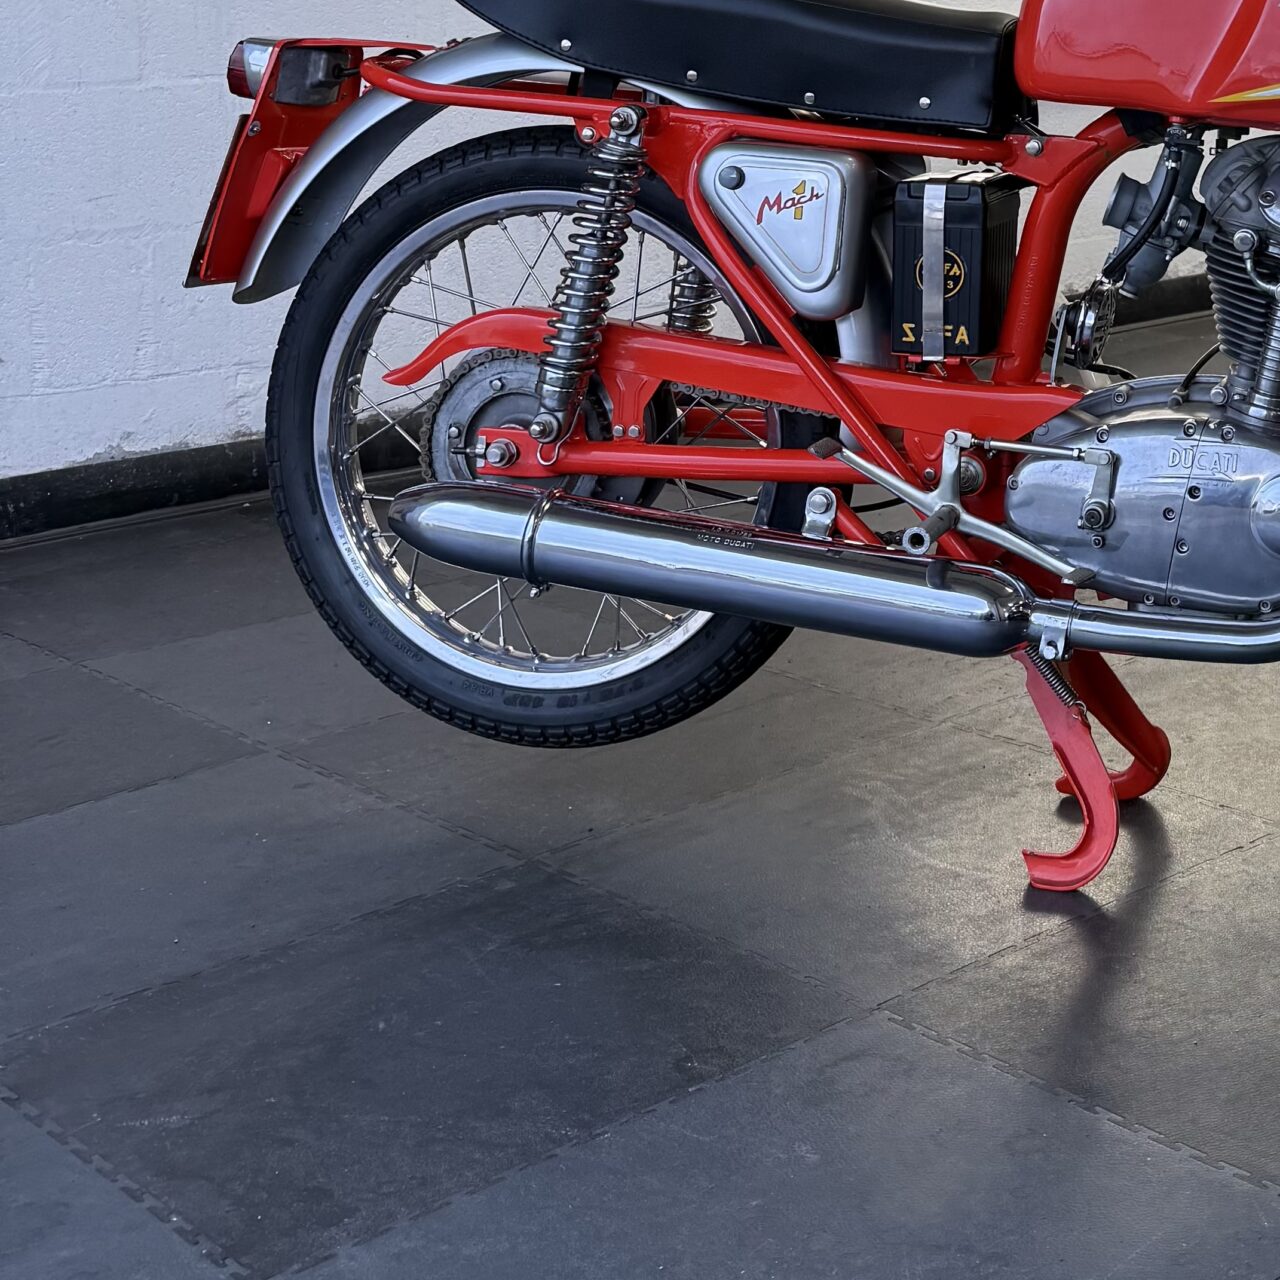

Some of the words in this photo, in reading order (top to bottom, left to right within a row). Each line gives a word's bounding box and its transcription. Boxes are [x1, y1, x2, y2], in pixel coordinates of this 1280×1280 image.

[756, 186, 825, 225] Mach
[1168, 448, 1239, 473] DUCATI
[723, 538, 755, 550] DUCATI
